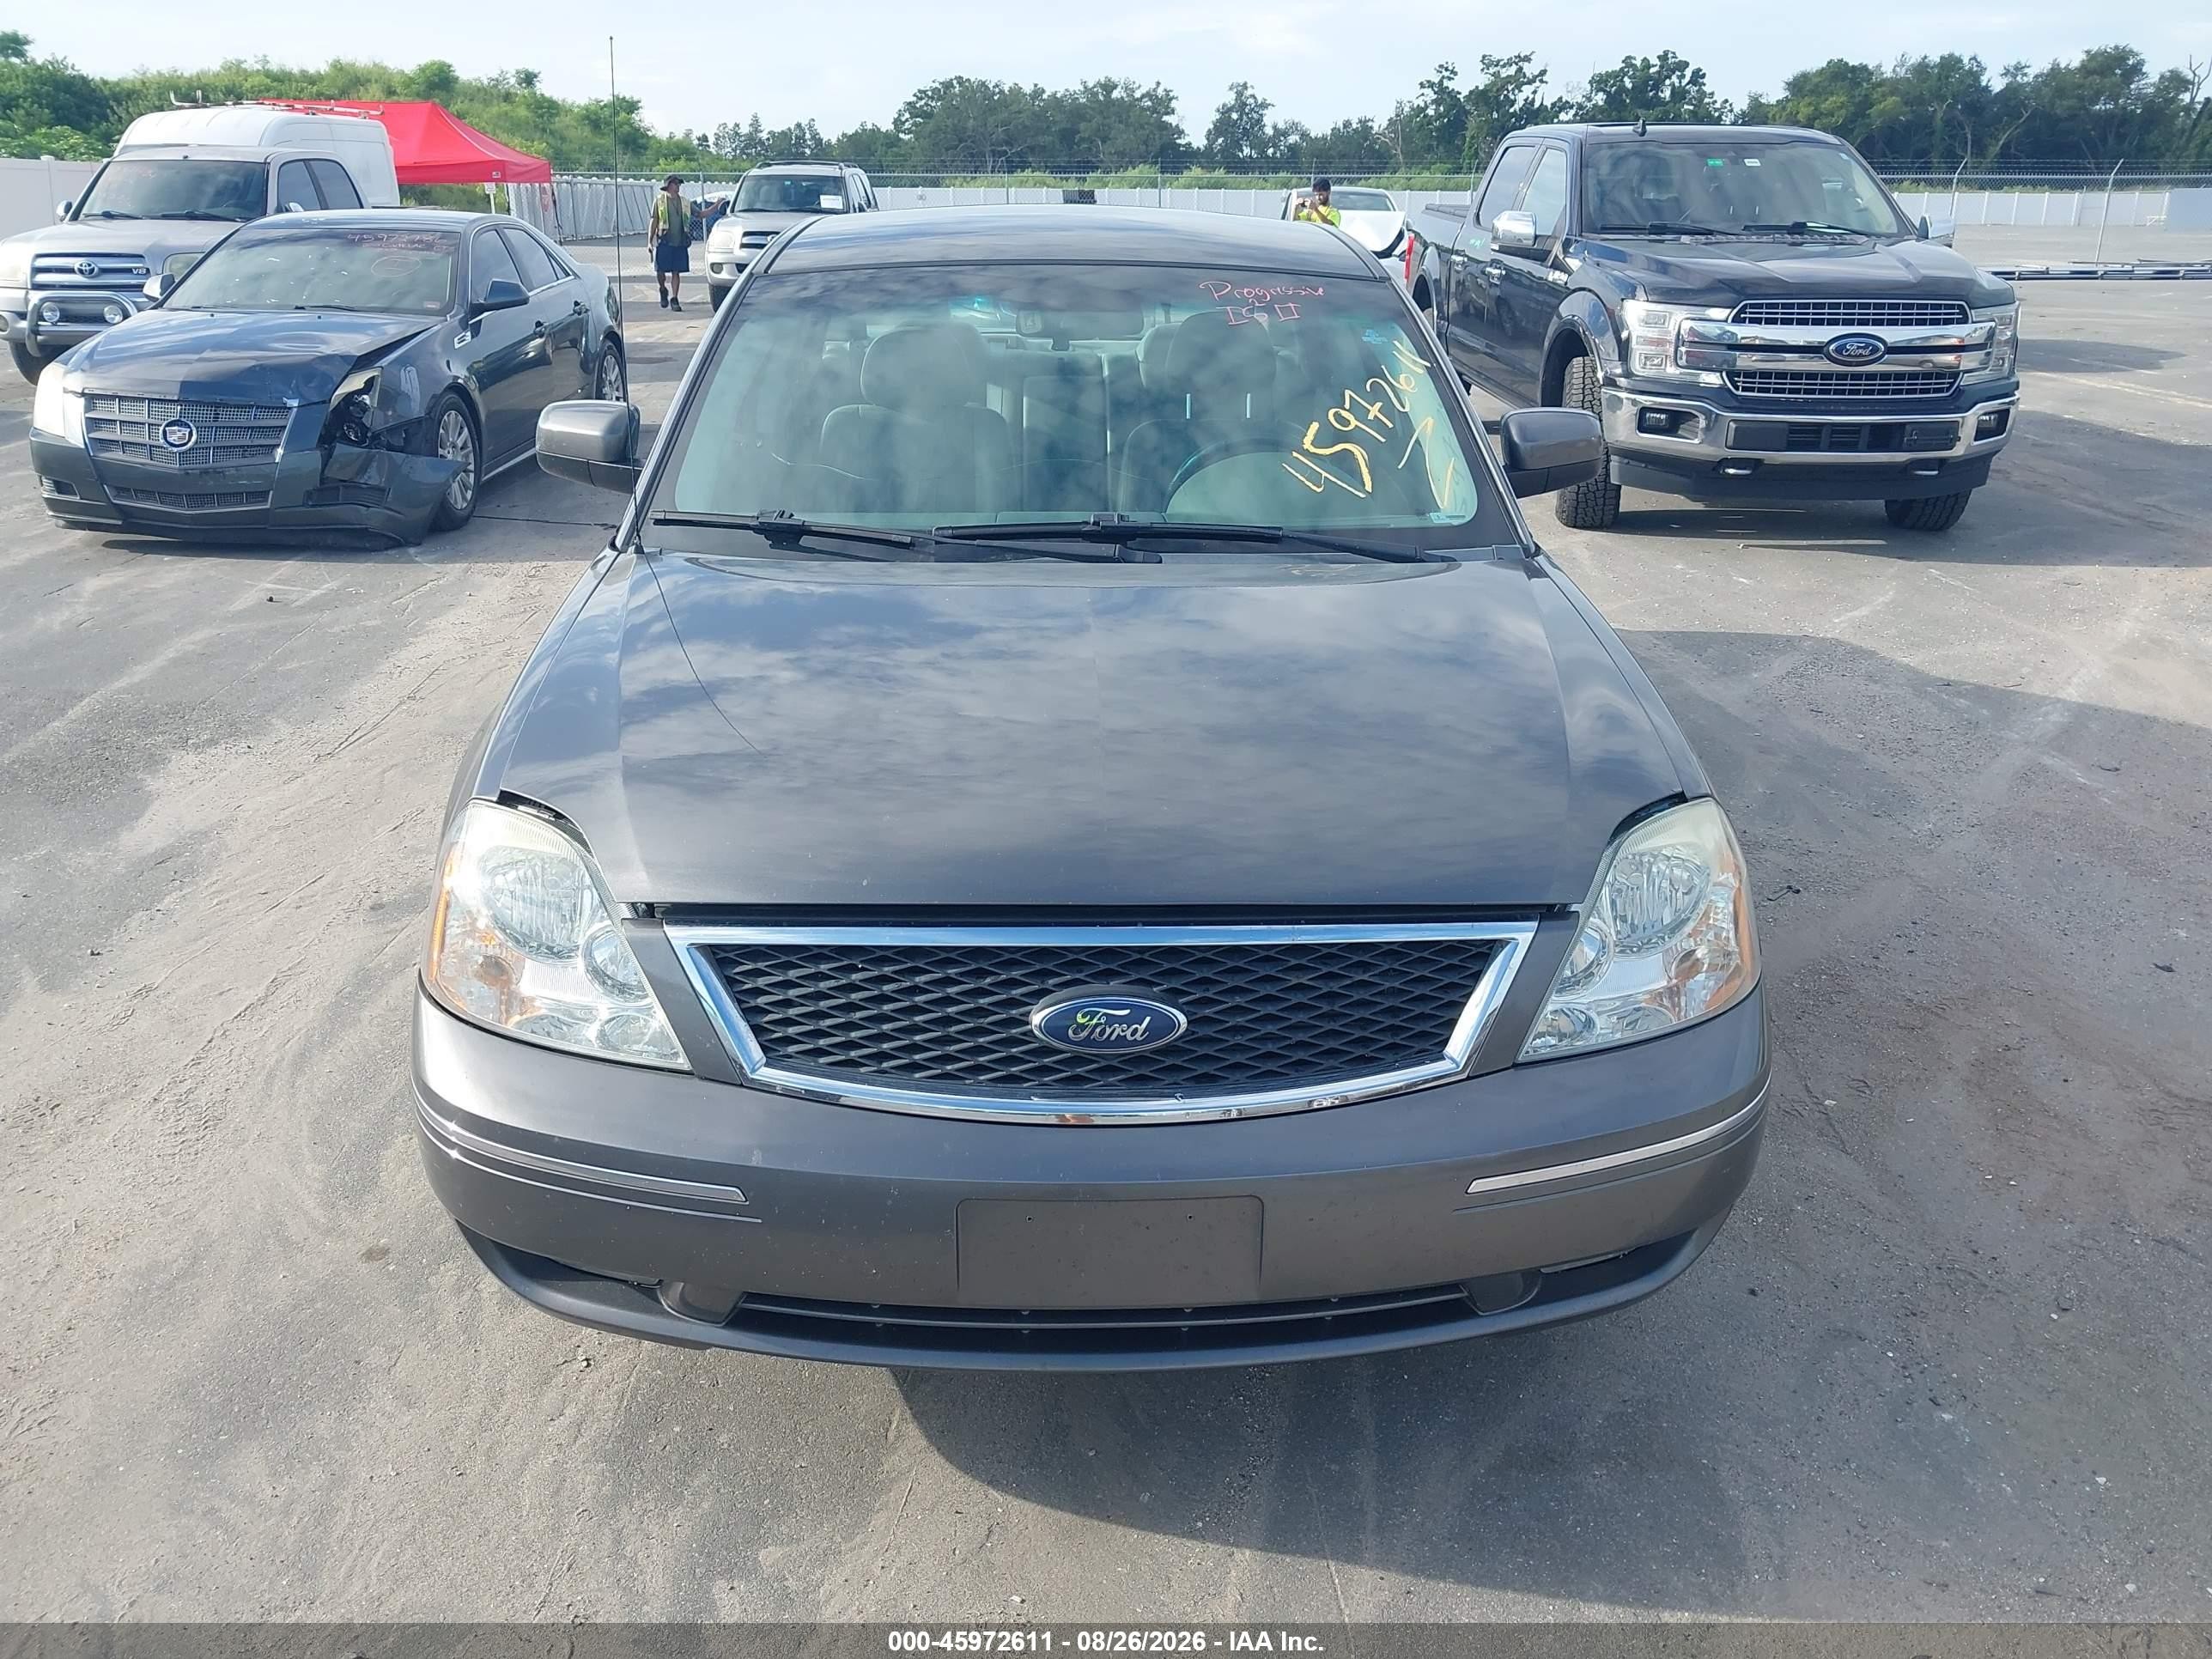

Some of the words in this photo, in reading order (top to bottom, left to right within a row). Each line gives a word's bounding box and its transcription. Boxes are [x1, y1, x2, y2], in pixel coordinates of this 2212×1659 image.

[1842, 343, 1873, 356] Ford
[1282, 340, 1431, 498] 45972611
[1067, 1007, 1152, 1042] Ford
